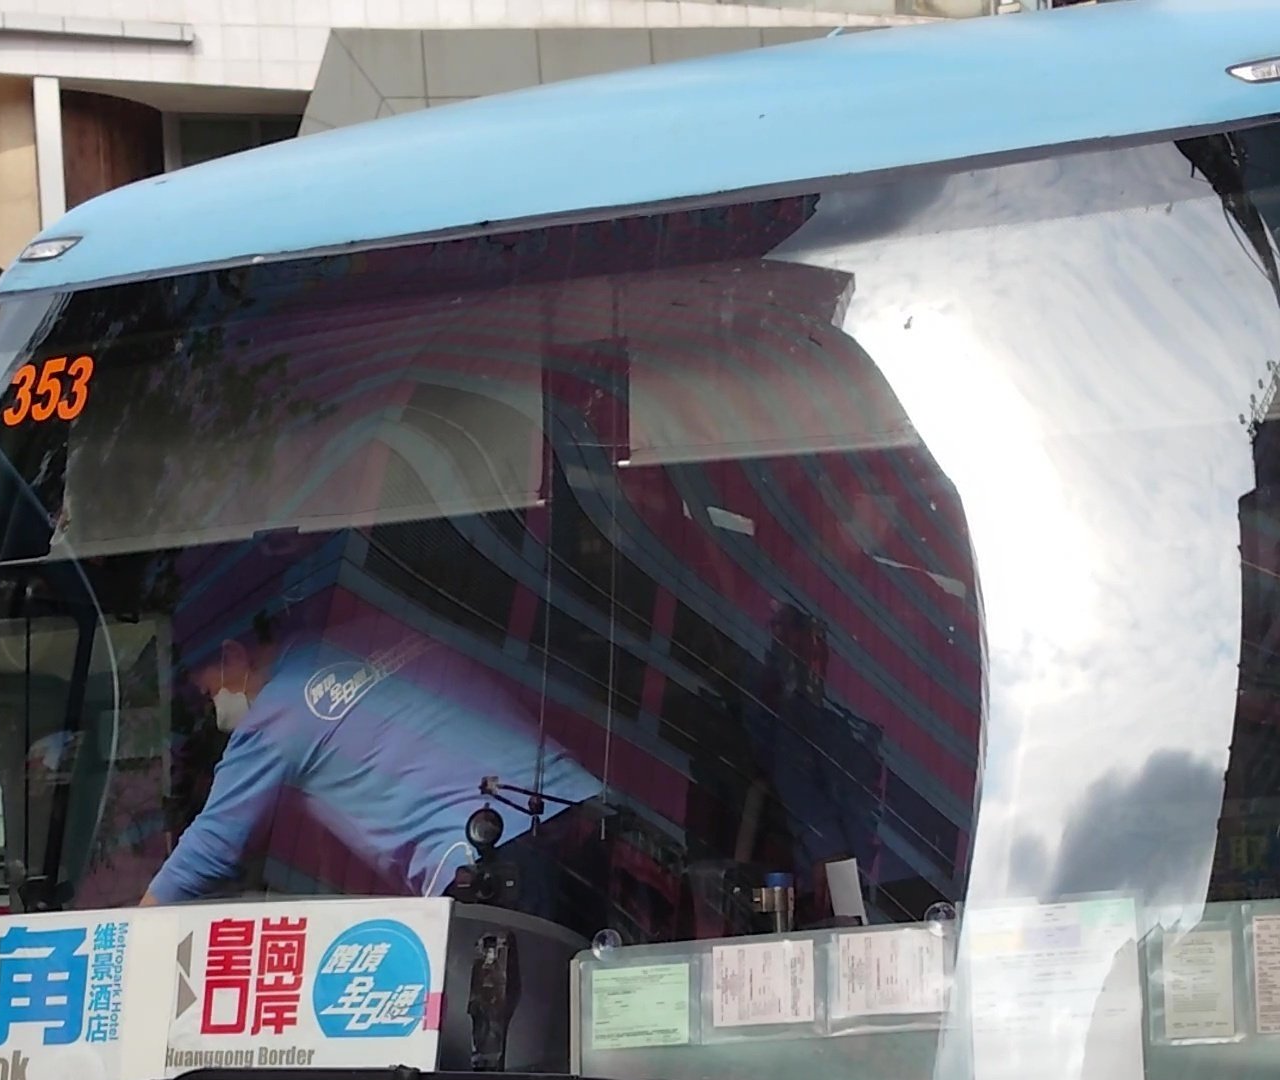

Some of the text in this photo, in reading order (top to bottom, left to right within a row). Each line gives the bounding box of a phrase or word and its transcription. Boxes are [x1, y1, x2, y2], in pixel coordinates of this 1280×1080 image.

[3, 355, 94, 426] 353
[205, 916, 308, 977] 皇崗
[85, 922, 116, 1042] 維景酒店
[108, 922, 129, 1040] Metropark Hotel
[199, 975, 303, 1036] 口岸
[257, 1046, 315, 1066] Border
